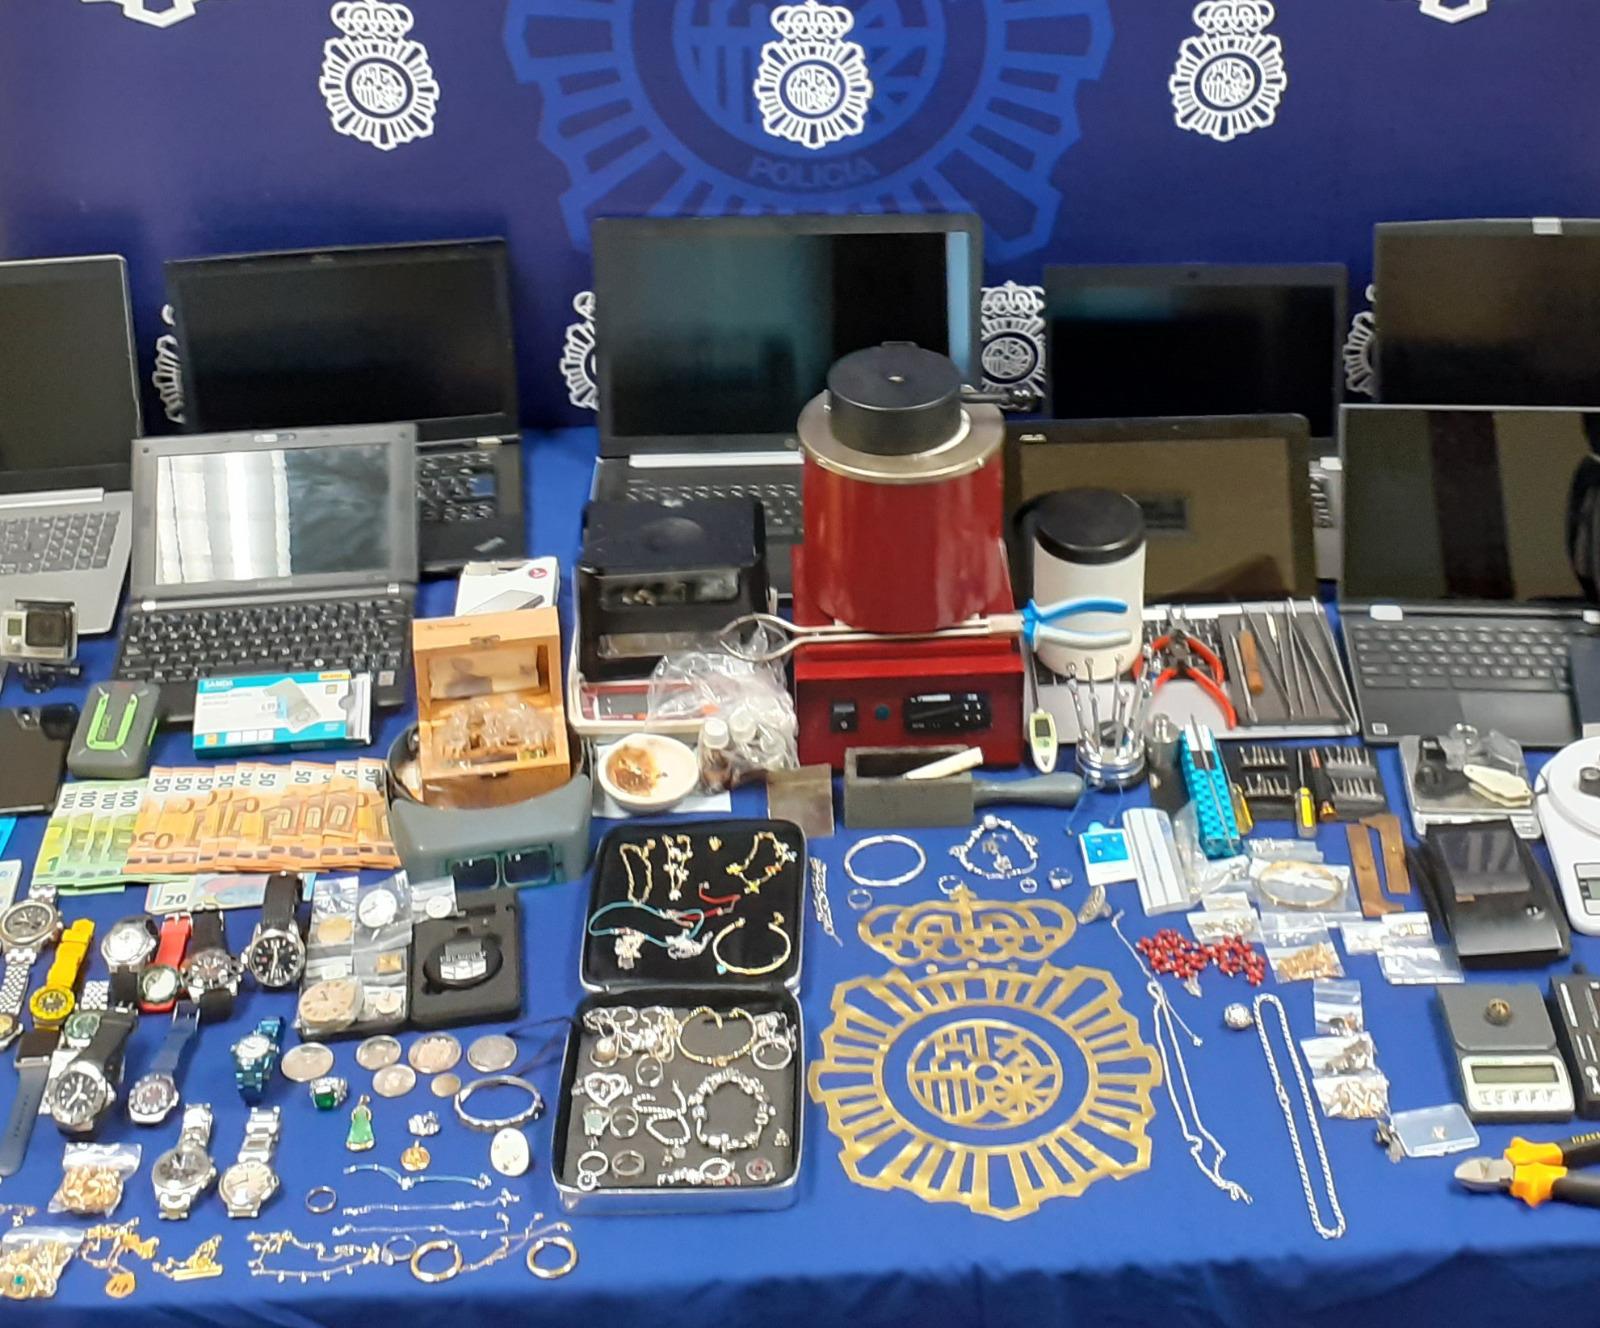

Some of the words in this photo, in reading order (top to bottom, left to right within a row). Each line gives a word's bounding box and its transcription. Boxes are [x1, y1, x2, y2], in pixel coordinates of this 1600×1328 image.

[747, 154, 880, 186] POLICIA
[175, 777, 192, 791] 50
[196, 777, 213, 791] 50
[259, 773, 276, 787] 50
[294, 770, 311, 784] 50
[153, 778, 171, 793] 50
[79, 790, 98, 808] 100
[120, 790, 138, 808] 100
[163, 894, 187, 906] 20
